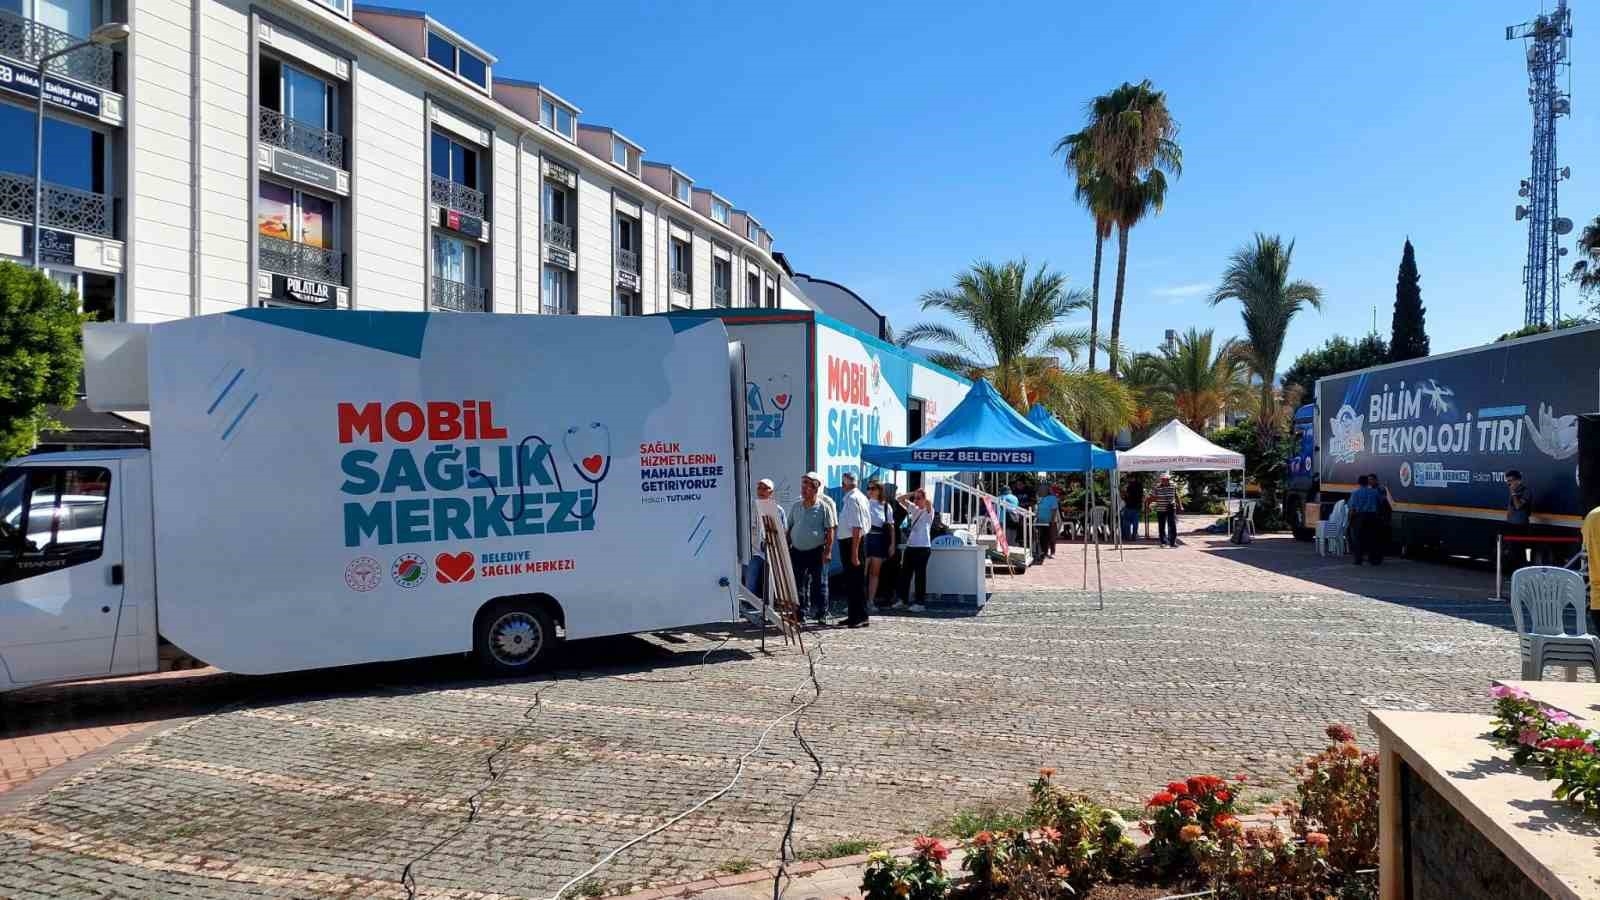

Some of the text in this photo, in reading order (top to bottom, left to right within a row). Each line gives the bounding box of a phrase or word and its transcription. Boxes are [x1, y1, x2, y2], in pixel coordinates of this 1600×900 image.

[71, 91, 99, 107] AKYOL
[287, 277, 329, 298] POLATLAR
[1368, 382, 1424, 423] BİLİM
[1369, 412, 1524, 455] TEKNOLOJİ TIRI
[640, 440, 680, 454] SAĞLIK
[913, 451, 954, 460] KEPEZ
[340, 444, 554, 496] SAĞLIK
[641, 466, 724, 479] MAHALLELERE
